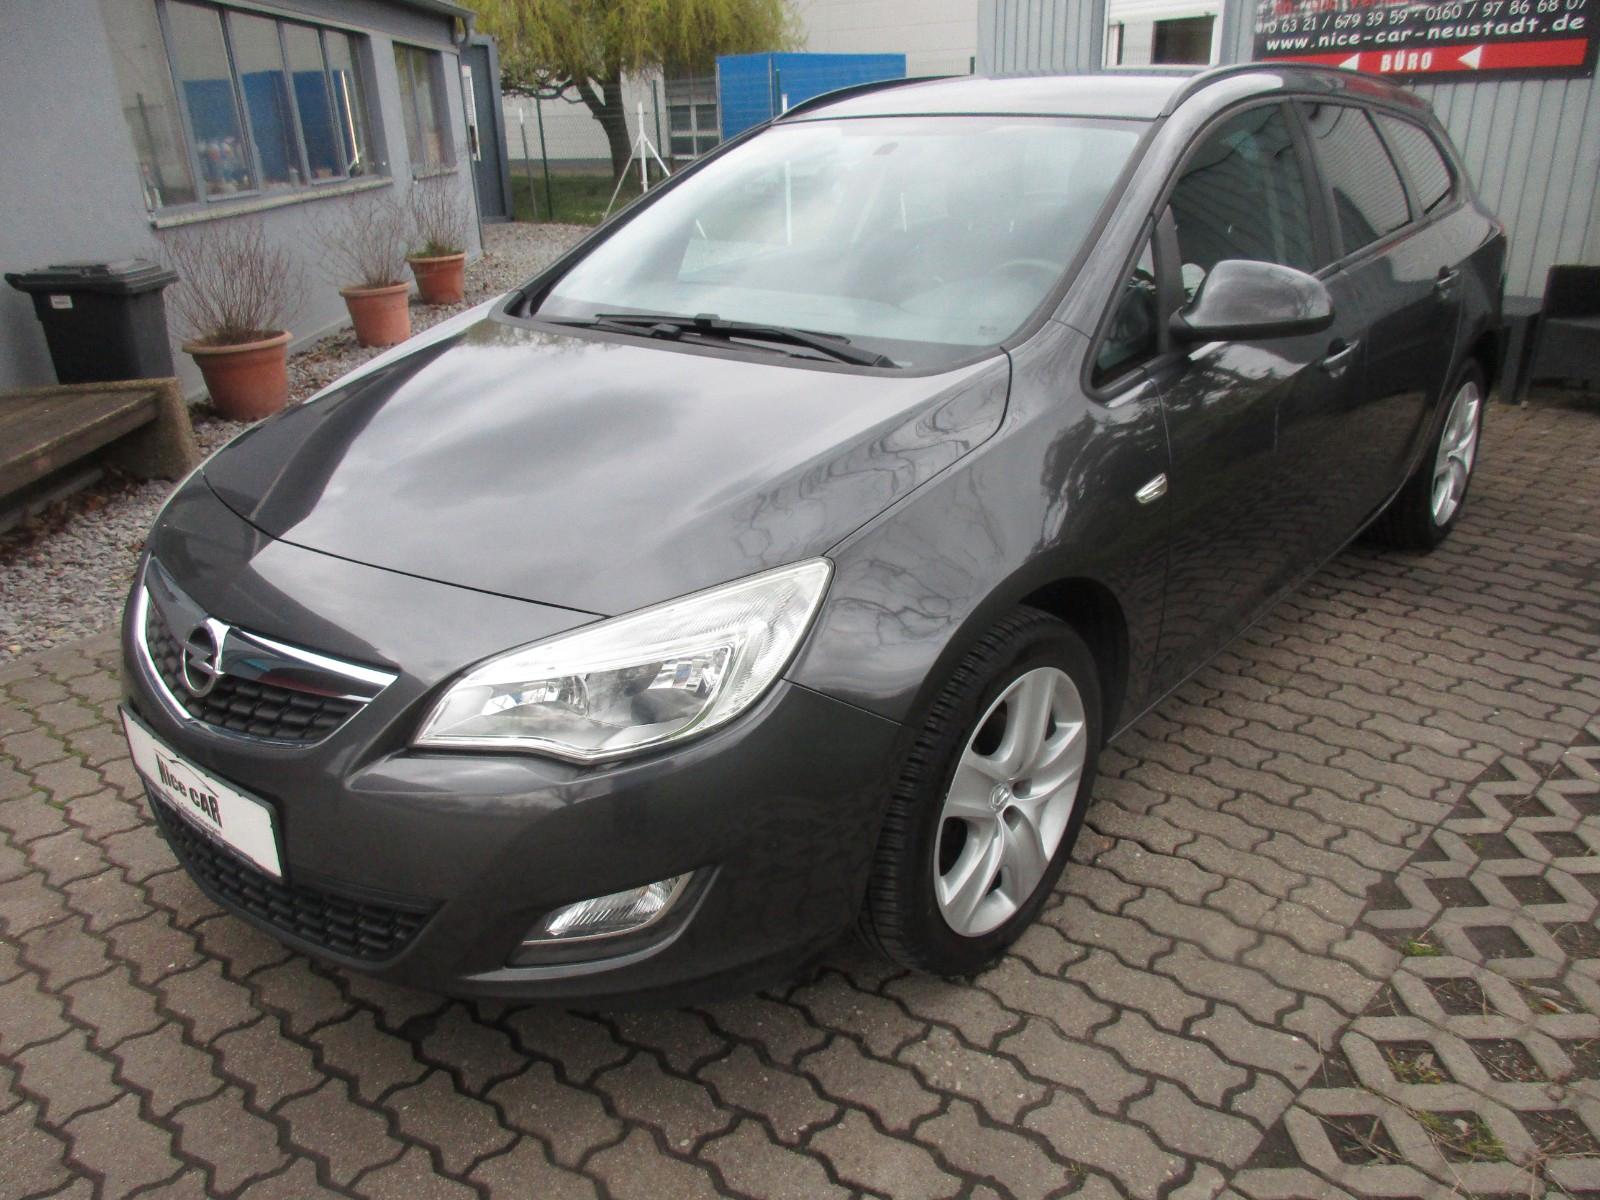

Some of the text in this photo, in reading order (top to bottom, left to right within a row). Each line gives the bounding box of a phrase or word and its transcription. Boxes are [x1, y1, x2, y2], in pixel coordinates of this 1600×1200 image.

[1266, 13, 1585, 50] www.nice-car-neustadt.de
[1281, 19, 1297, 33] 63
[1302, 16, 1317, 31] 21
[1321, 15, 1331, 30] /
[1334, 13, 1361, 29] 679
[1366, 11, 1384, 27] 39
[1389, 9, 1408, 25] 59
[1425, 3, 1462, 21] 0160
[1466, 3, 1477, 18] /
[1482, 1, 1503, 17] 97
[1509, 0, 1530, 15] 86
[1537, 0, 1559, 13] 68
